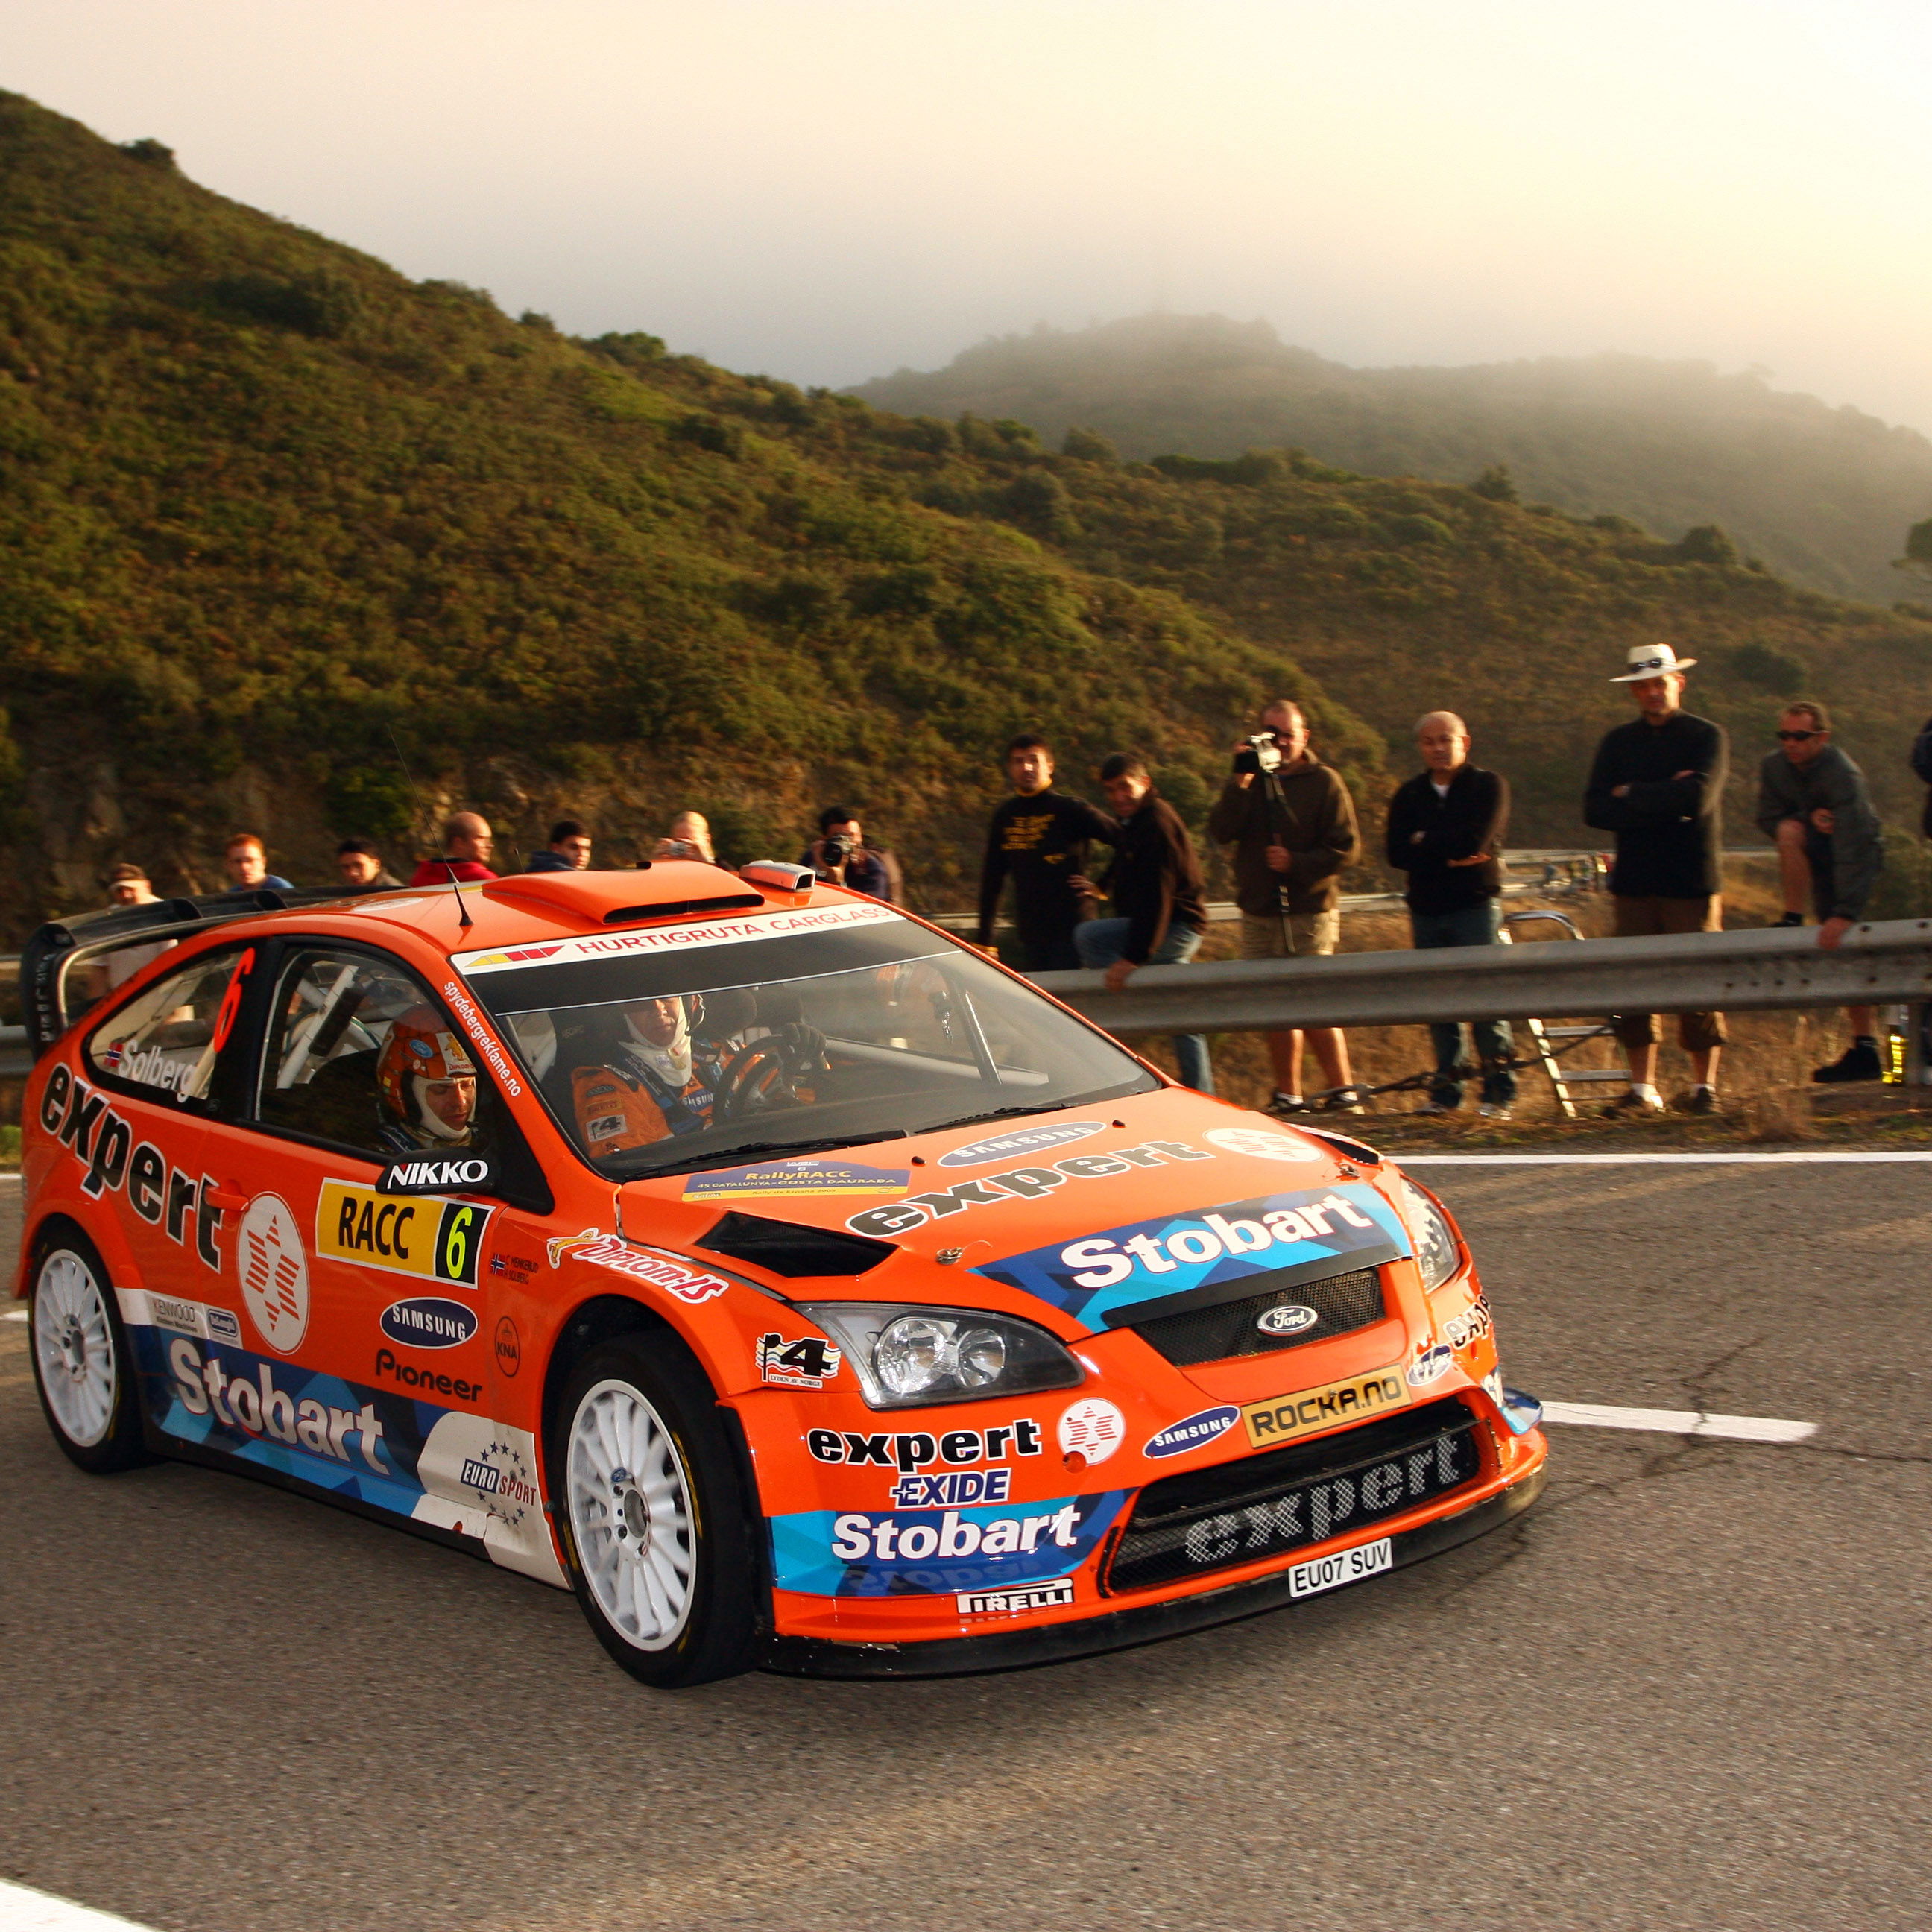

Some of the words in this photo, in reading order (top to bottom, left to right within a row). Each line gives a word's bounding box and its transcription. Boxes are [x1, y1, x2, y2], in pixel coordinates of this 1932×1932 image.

[574, 921, 764, 954] HURTIGRUTA
[769, 907, 890, 932] CARGLASS
[444, 982, 521, 1097] spydebergreklame.no
[118, 1039, 198, 1103] Solberg
[953, 1123, 1092, 1158] SAMSUNG
[40, 1061, 226, 1274] expert
[387, 1160, 489, 1190] NIKKO
[745, 1170, 852, 1181] RallyRACC
[845, 1140, 1216, 1239] expert
[338, 1196, 415, 1260] RACC
[446, 1207, 473, 1278] 6
[1059, 1191, 1375, 1289] Stobart
[392, 1304, 466, 1341] SAMSUNG
[1273, 1308, 1307, 1328] Ford
[376, 1348, 483, 1402] Pioneer
[497, 1341, 517, 1360] KNA
[171, 1337, 391, 1476] Stobart
[799, 1379, 821, 1387] NORGE
[807, 1418, 1042, 1475] expert
[1154, 1415, 1231, 1448] SAMSUNG
[462, 1462, 497, 1491] EURO
[499, 1475, 537, 1506] SPORT
[891, 1468, 1011, 1509] EXIDE
[1184, 1433, 1459, 1563] expert
[831, 1504, 1082, 1560] Stobart
[1295, 1556, 1343, 1593] EU07
[1351, 1542, 1390, 1574] SUV
[958, 1578, 1074, 1614] PIRELLI
